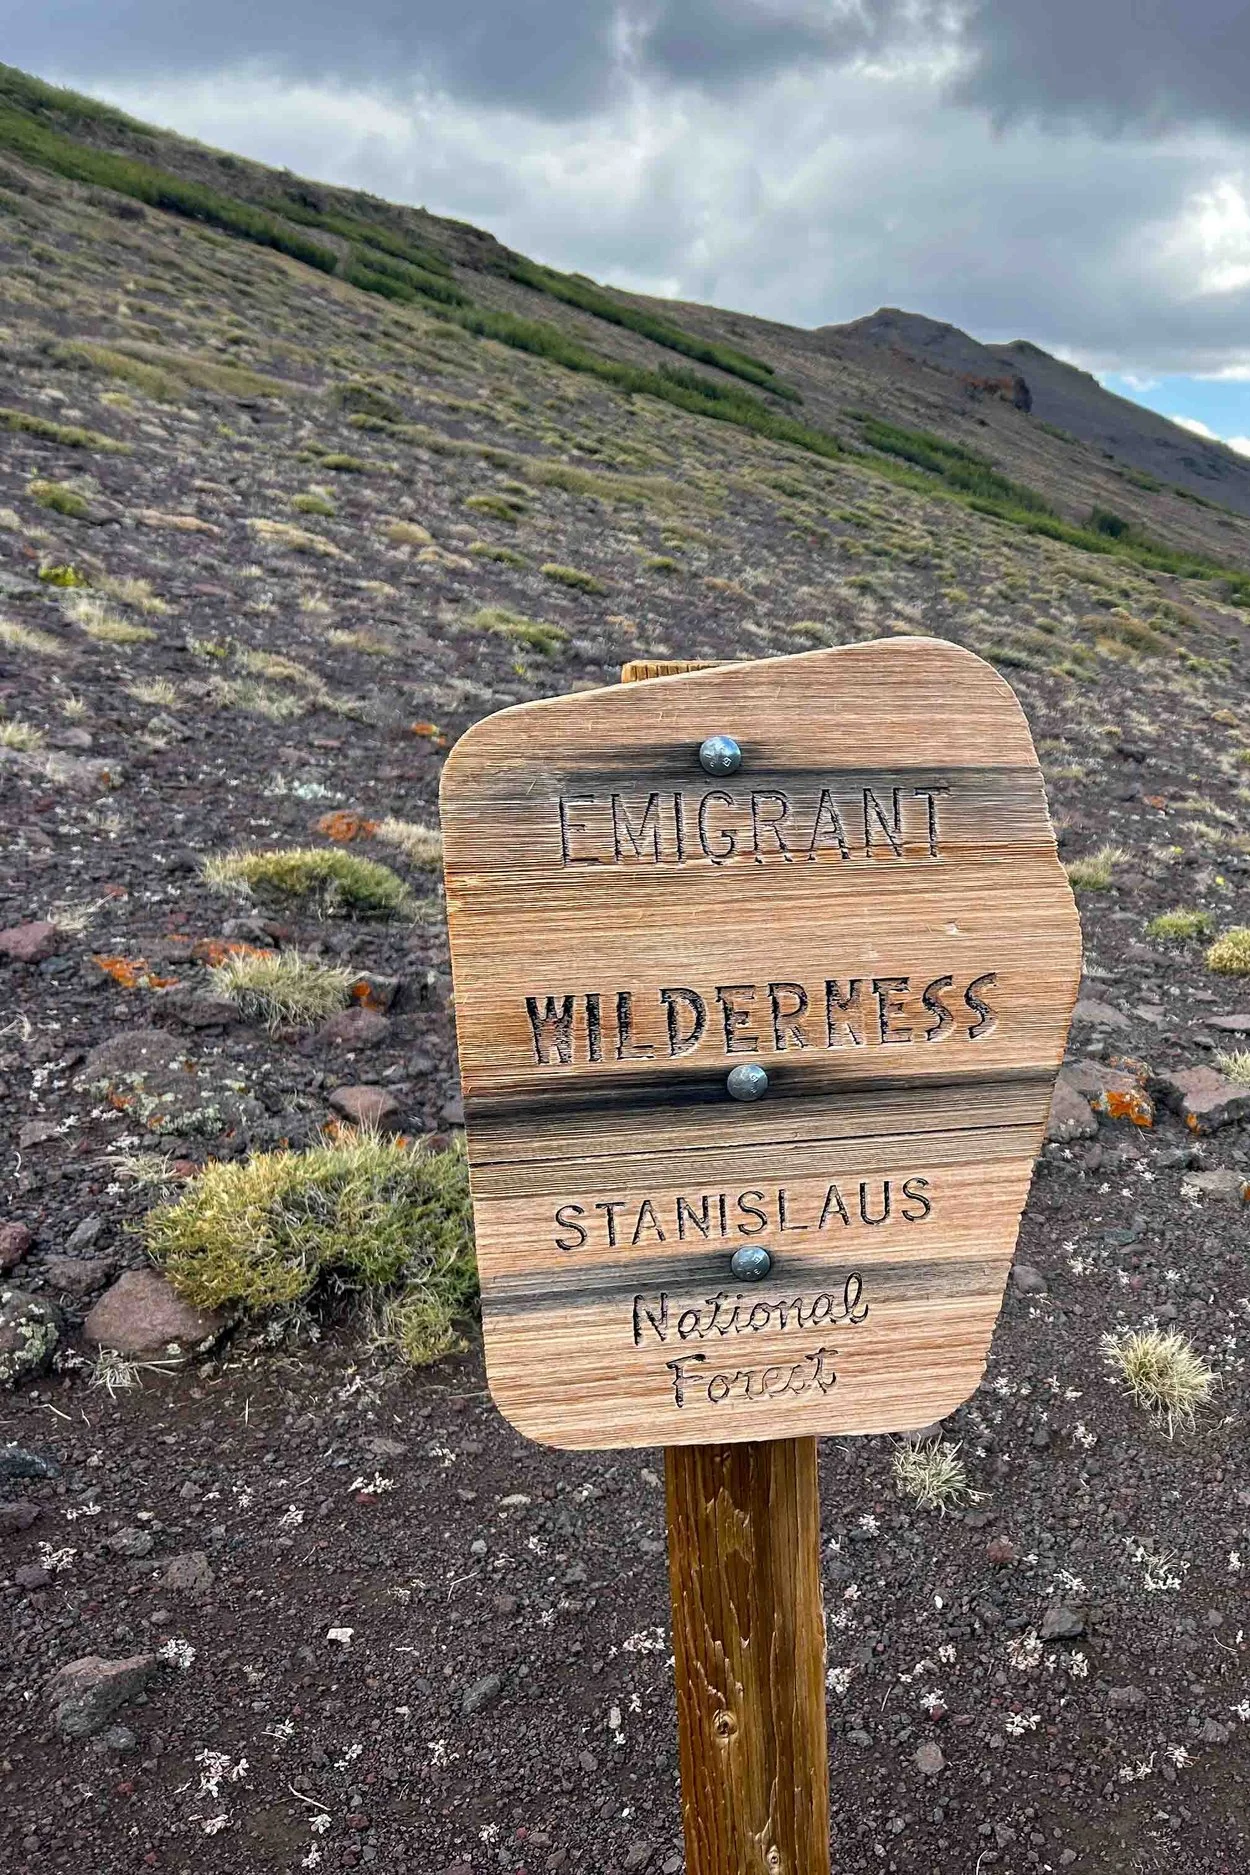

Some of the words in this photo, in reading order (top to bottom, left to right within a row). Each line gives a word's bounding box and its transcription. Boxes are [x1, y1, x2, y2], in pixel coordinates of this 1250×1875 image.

[558, 786, 951, 868] EMIGRANT
[525, 972, 999, 1065] WILDERNESS
[554, 1177, 932, 1251] STANISLAUS
[632, 1272, 869, 1346] National
[666, 1347, 839, 1408] Forest
